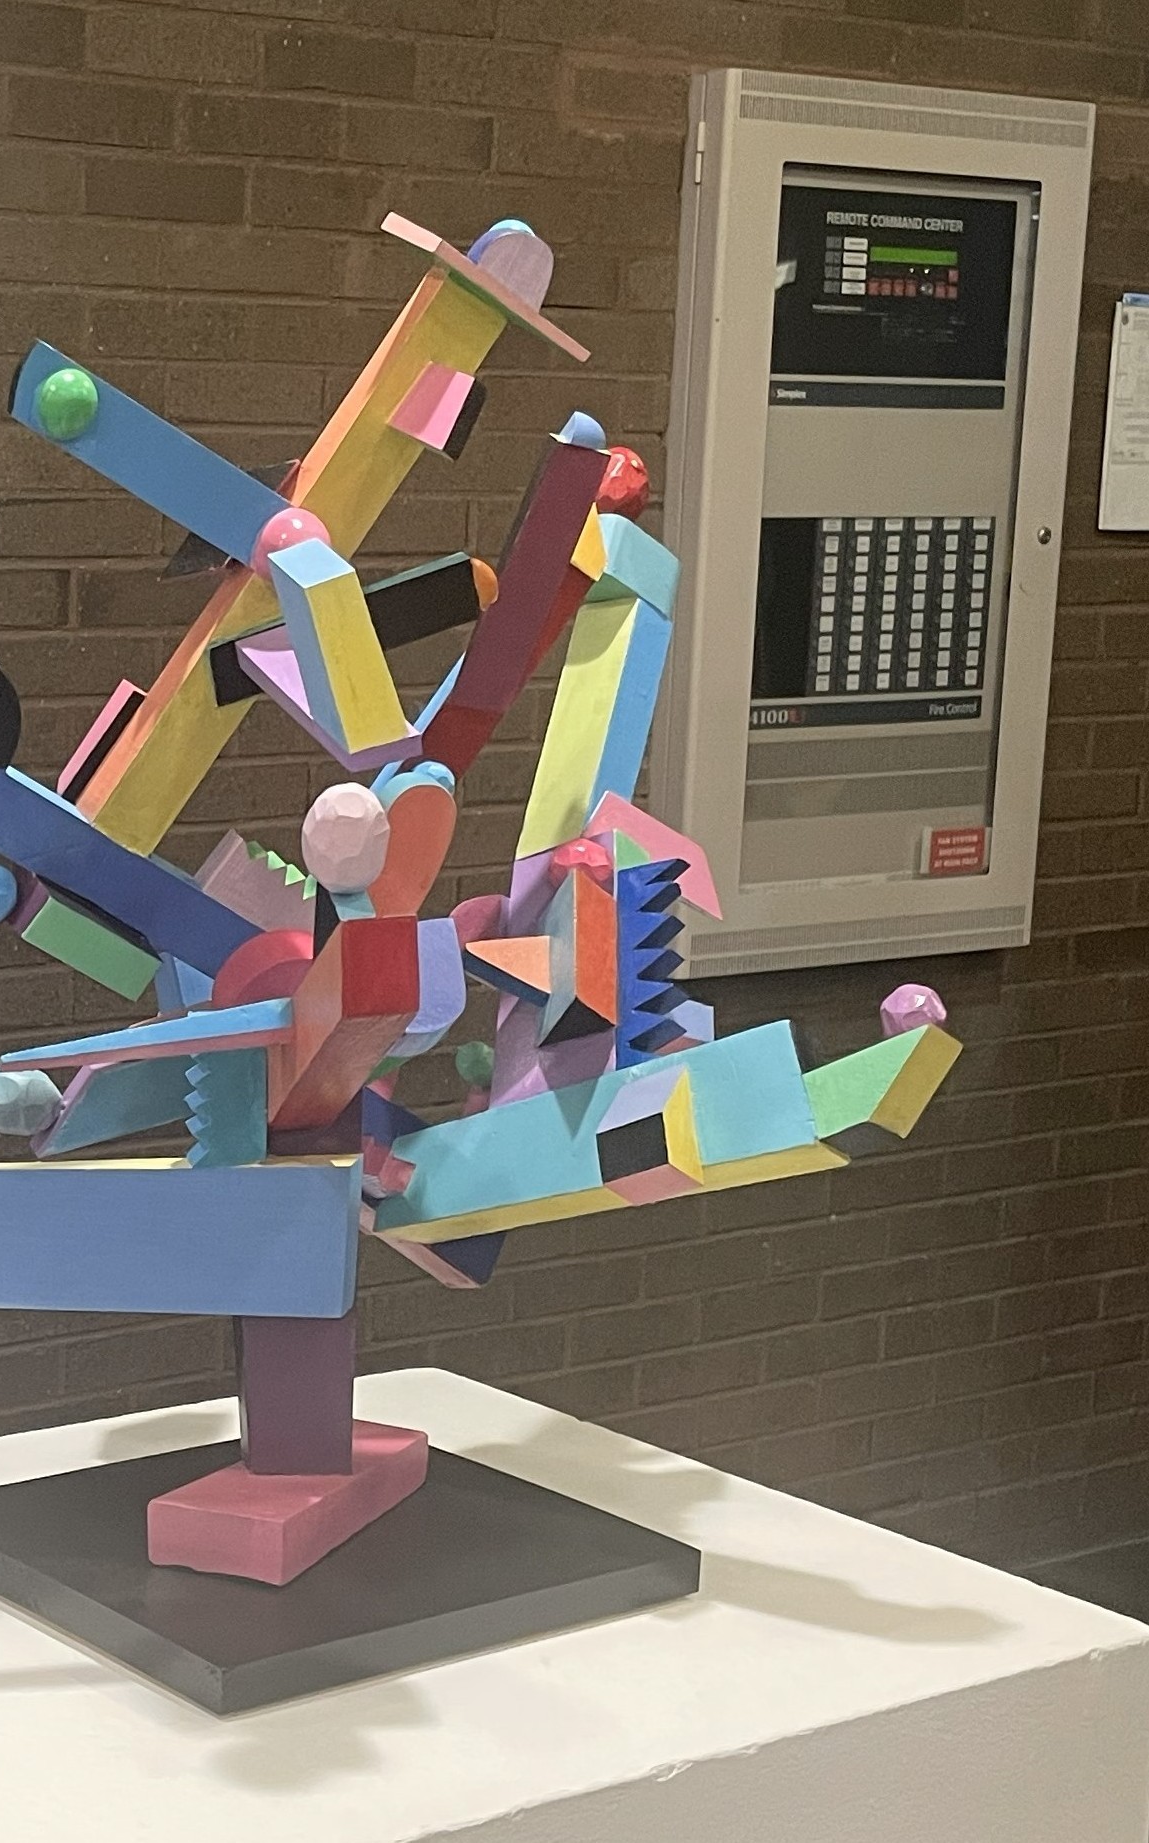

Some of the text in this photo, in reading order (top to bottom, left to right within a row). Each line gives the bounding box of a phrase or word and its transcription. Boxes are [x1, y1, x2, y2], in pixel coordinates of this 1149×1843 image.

[826, 211, 964, 233] REMOTE COMMAND CENTER
[929, 701, 978, 715] Fire Control
